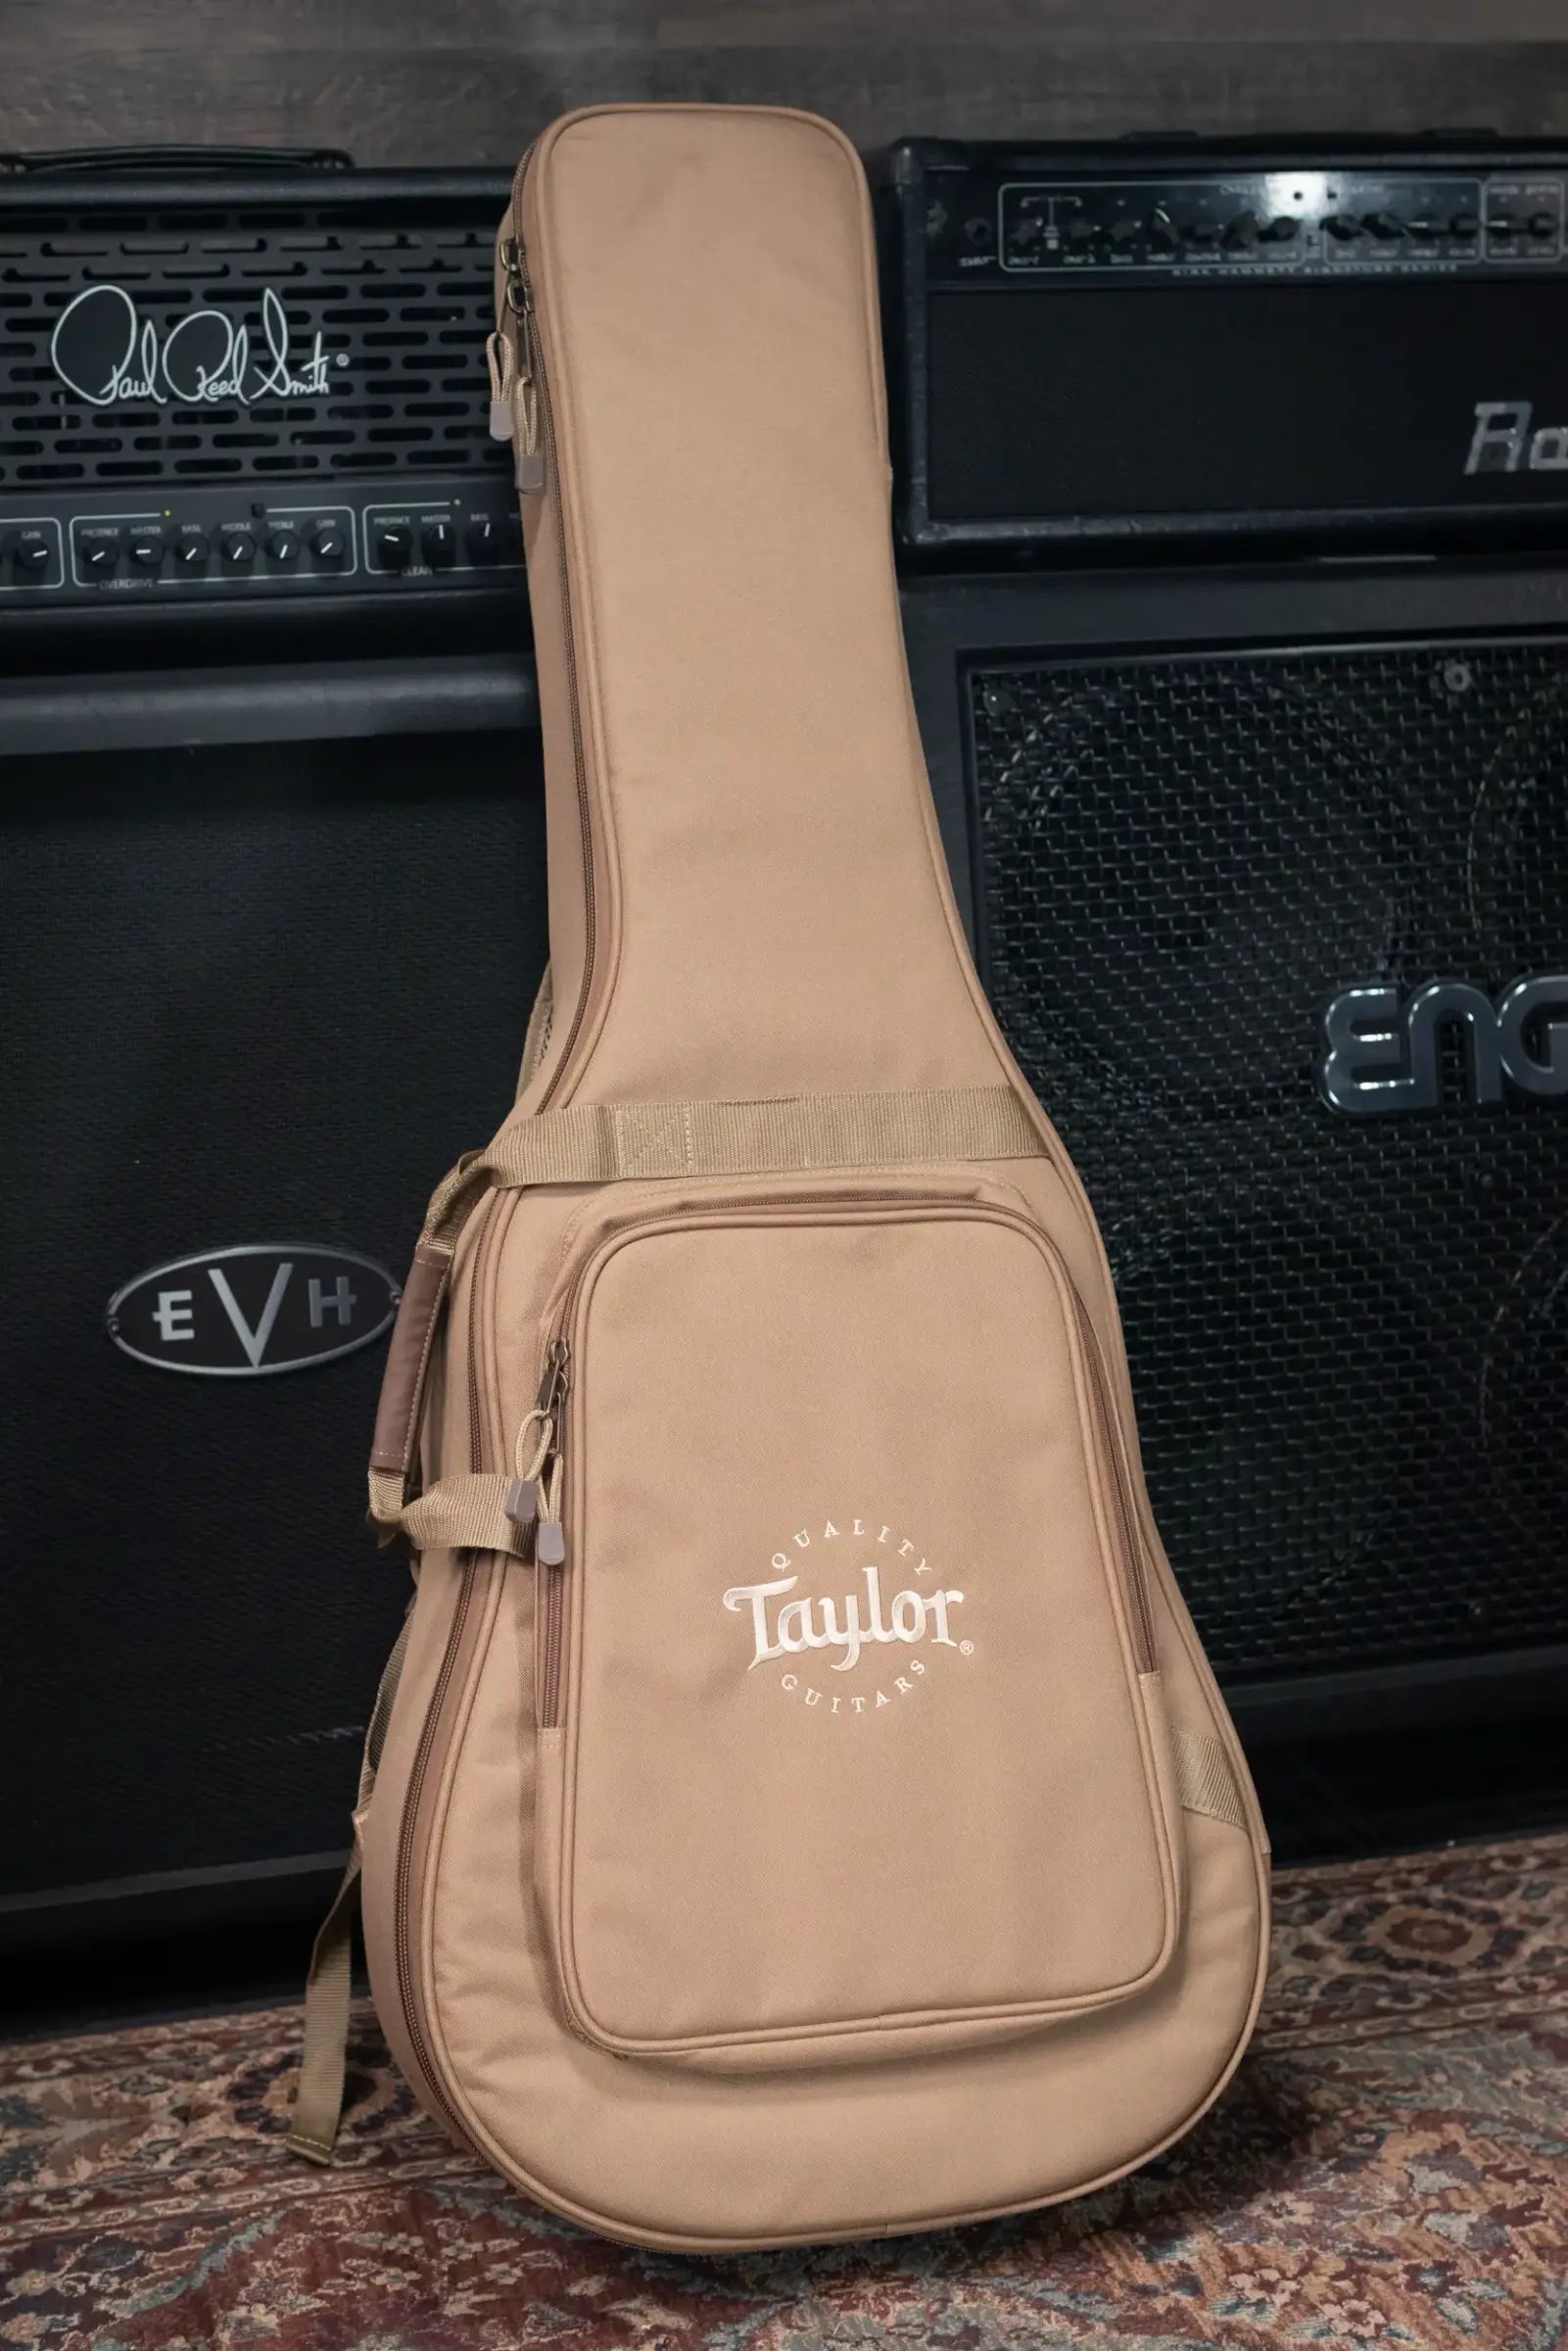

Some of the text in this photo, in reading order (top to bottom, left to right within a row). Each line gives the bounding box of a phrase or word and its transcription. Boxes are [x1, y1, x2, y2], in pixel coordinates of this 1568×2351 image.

[50, 284, 330, 406] Paul Reed Smith
[152, 1262, 357, 1369] EVH
[771, 1518, 932, 1577] QUALITY
[723, 1565, 965, 1672] Taylor
[781, 1658, 926, 1714] GUITARS
